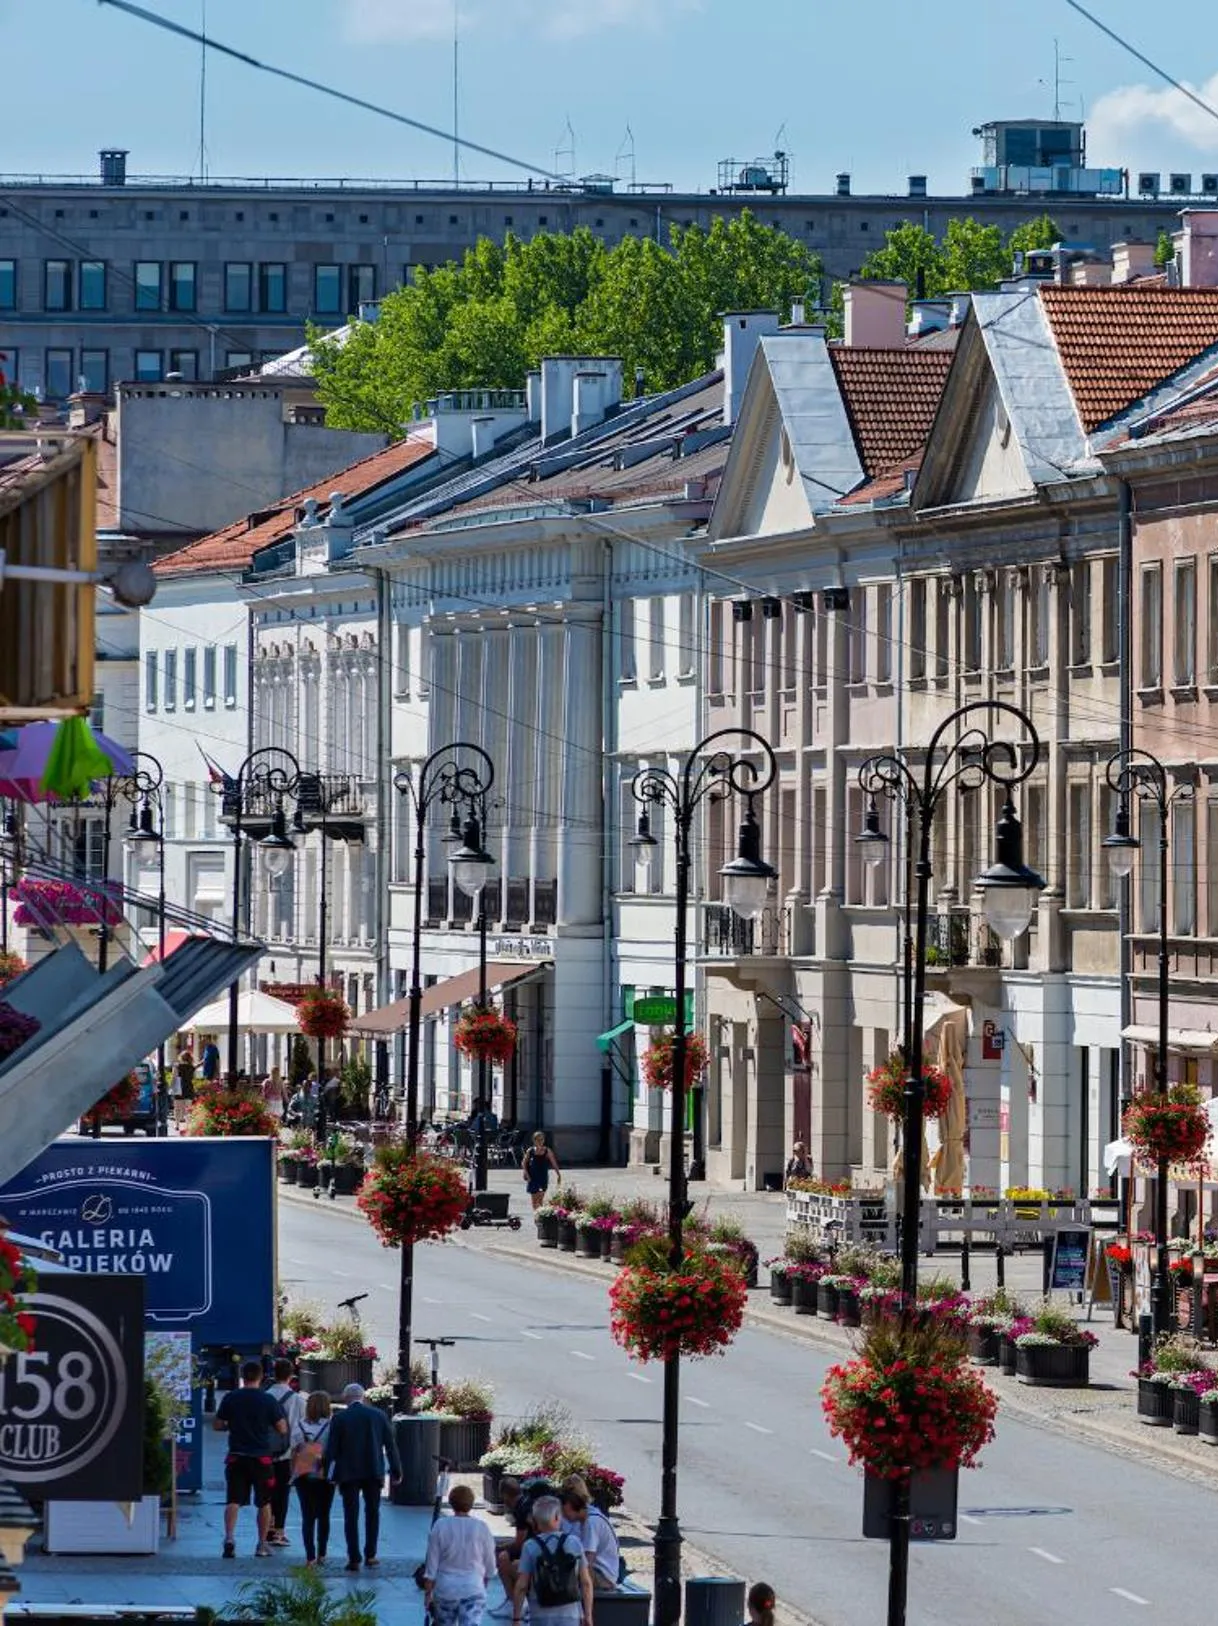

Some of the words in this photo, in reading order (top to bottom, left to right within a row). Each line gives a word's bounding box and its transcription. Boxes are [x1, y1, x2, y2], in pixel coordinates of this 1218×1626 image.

[42, 1167, 84, 1182] PROSTO
[99, 1165, 151, 1181] PIEKARNI
[40, 1229, 155, 1249] GALERIA
[67, 1250, 173, 1273] PIEKÓW
[0, 1423, 61, 1459] CLUB
